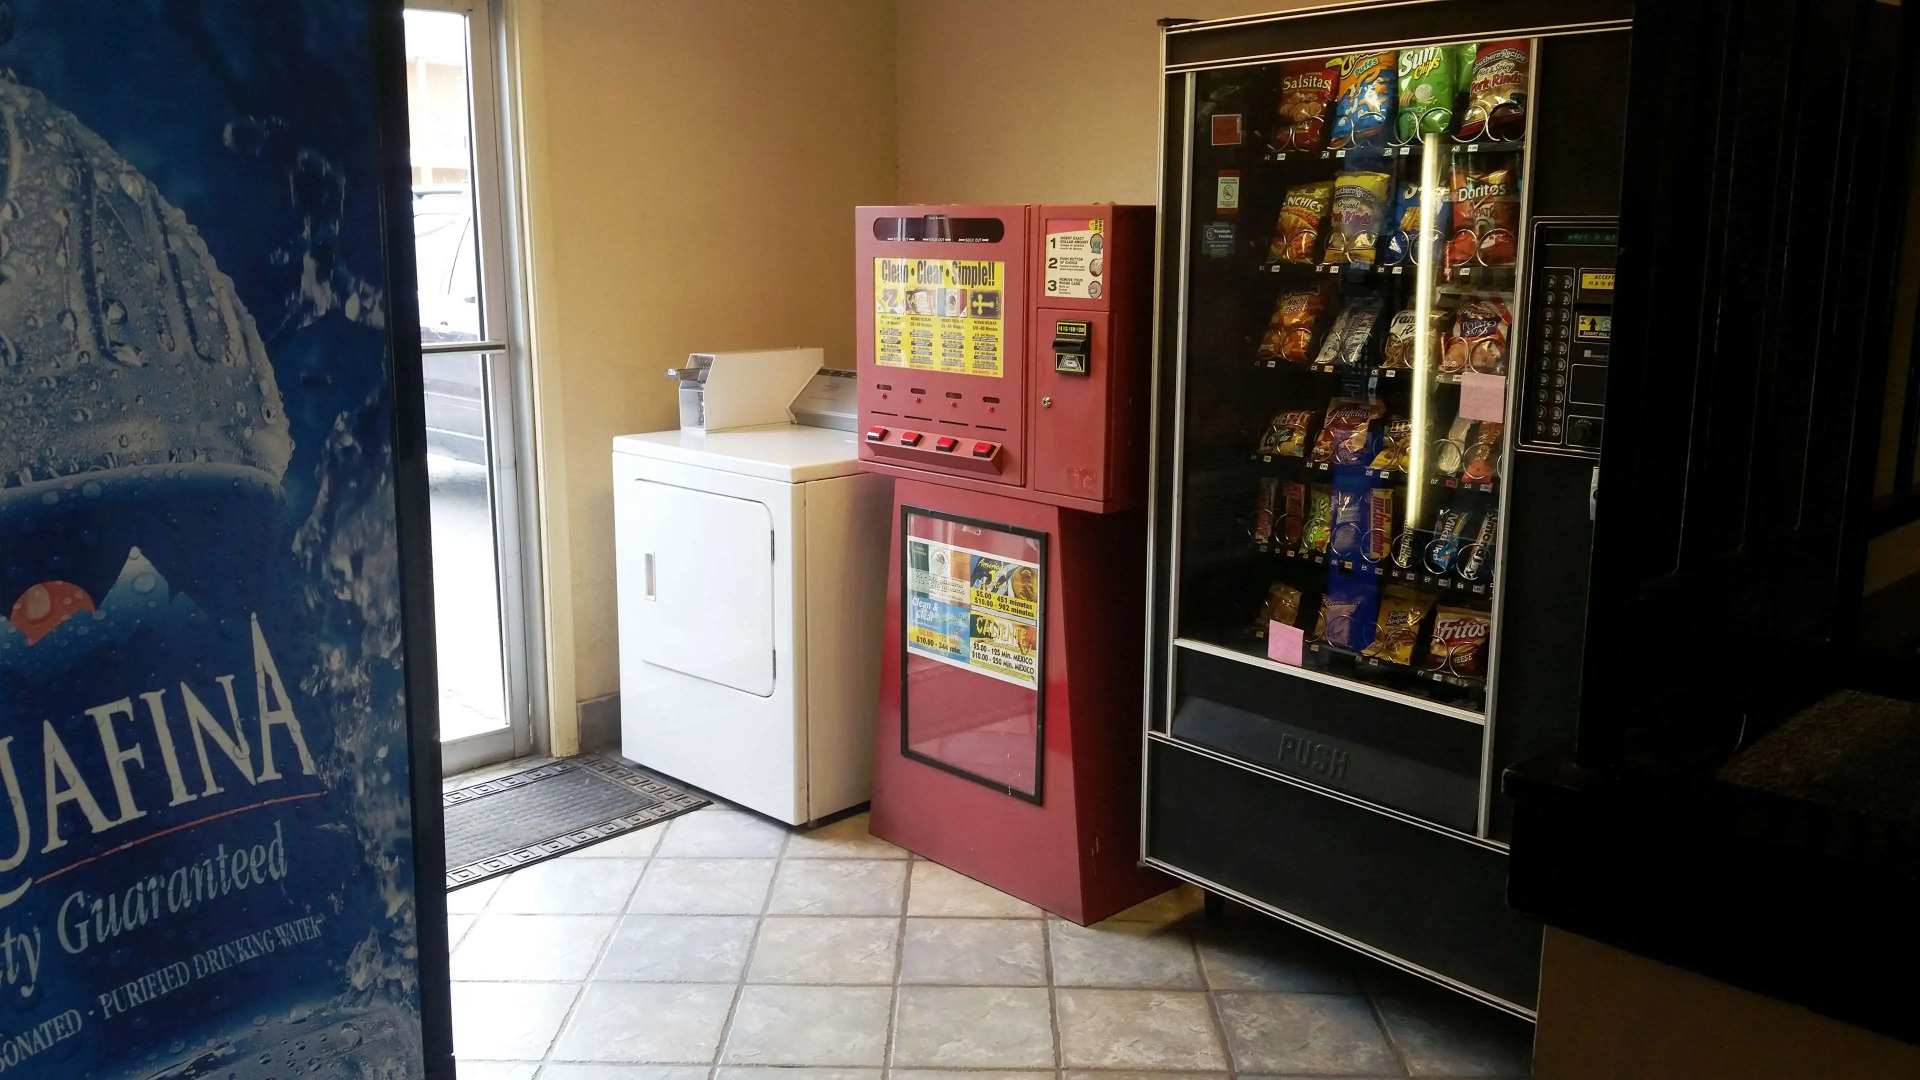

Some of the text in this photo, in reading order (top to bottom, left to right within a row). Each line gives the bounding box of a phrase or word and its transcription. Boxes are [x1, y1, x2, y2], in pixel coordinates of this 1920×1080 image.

[1399, 46, 1435, 77] Sun
[1413, 57, 1441, 80] Chips
[1282, 74, 1332, 91] Salsitas
[1458, 183, 1507, 202] Doritos
[1283, 196, 1325, 213] NCHIES
[1050, 237, 1056, 249] 1
[1048, 257, 1058, 269] 2
[881, 260, 995, 289] Clean Clear Simple!!
[1047, 279, 1057, 292] 3
[1440, 512, 1459, 543] Mike
[912, 597, 940, 612] Clean &
[974, 597, 994, 608] $10.00
[998, 602, 1010, 612] 902
[1010, 607, 1035, 618] minutes
[976, 590, 992, 600] $5.00
[997, 595, 1008, 603] 451
[1009, 599, 1033, 610] minutes
[916, 609, 933, 622] Clear
[976, 616, 1027, 647] CALIENTE
[1437, 618, 1488, 641] Fritos
[916, 635, 934, 647] $10.00
[949, 646, 962, 655] min.
[973, 642, 988, 653] $5.00
[991, 648, 1001, 656] 125
[1001, 651, 1012, 660] Min.
[1013, 654, 1033, 665] MEXICO
[972, 650, 989, 662] $10.00
[1003, 660, 1013, 669] Min.
[1014, 663, 1035, 675] MEXICO
[1452, 652, 1473, 664] HEESE
[1277, 732, 1350, 780] PUSH
[57, 821, 289, 955] Guaranteed
[98, 960, 191, 1020] PURIFIED
[195, 929, 276, 980] DRINKING
[274, 918, 323, 955] WATER
